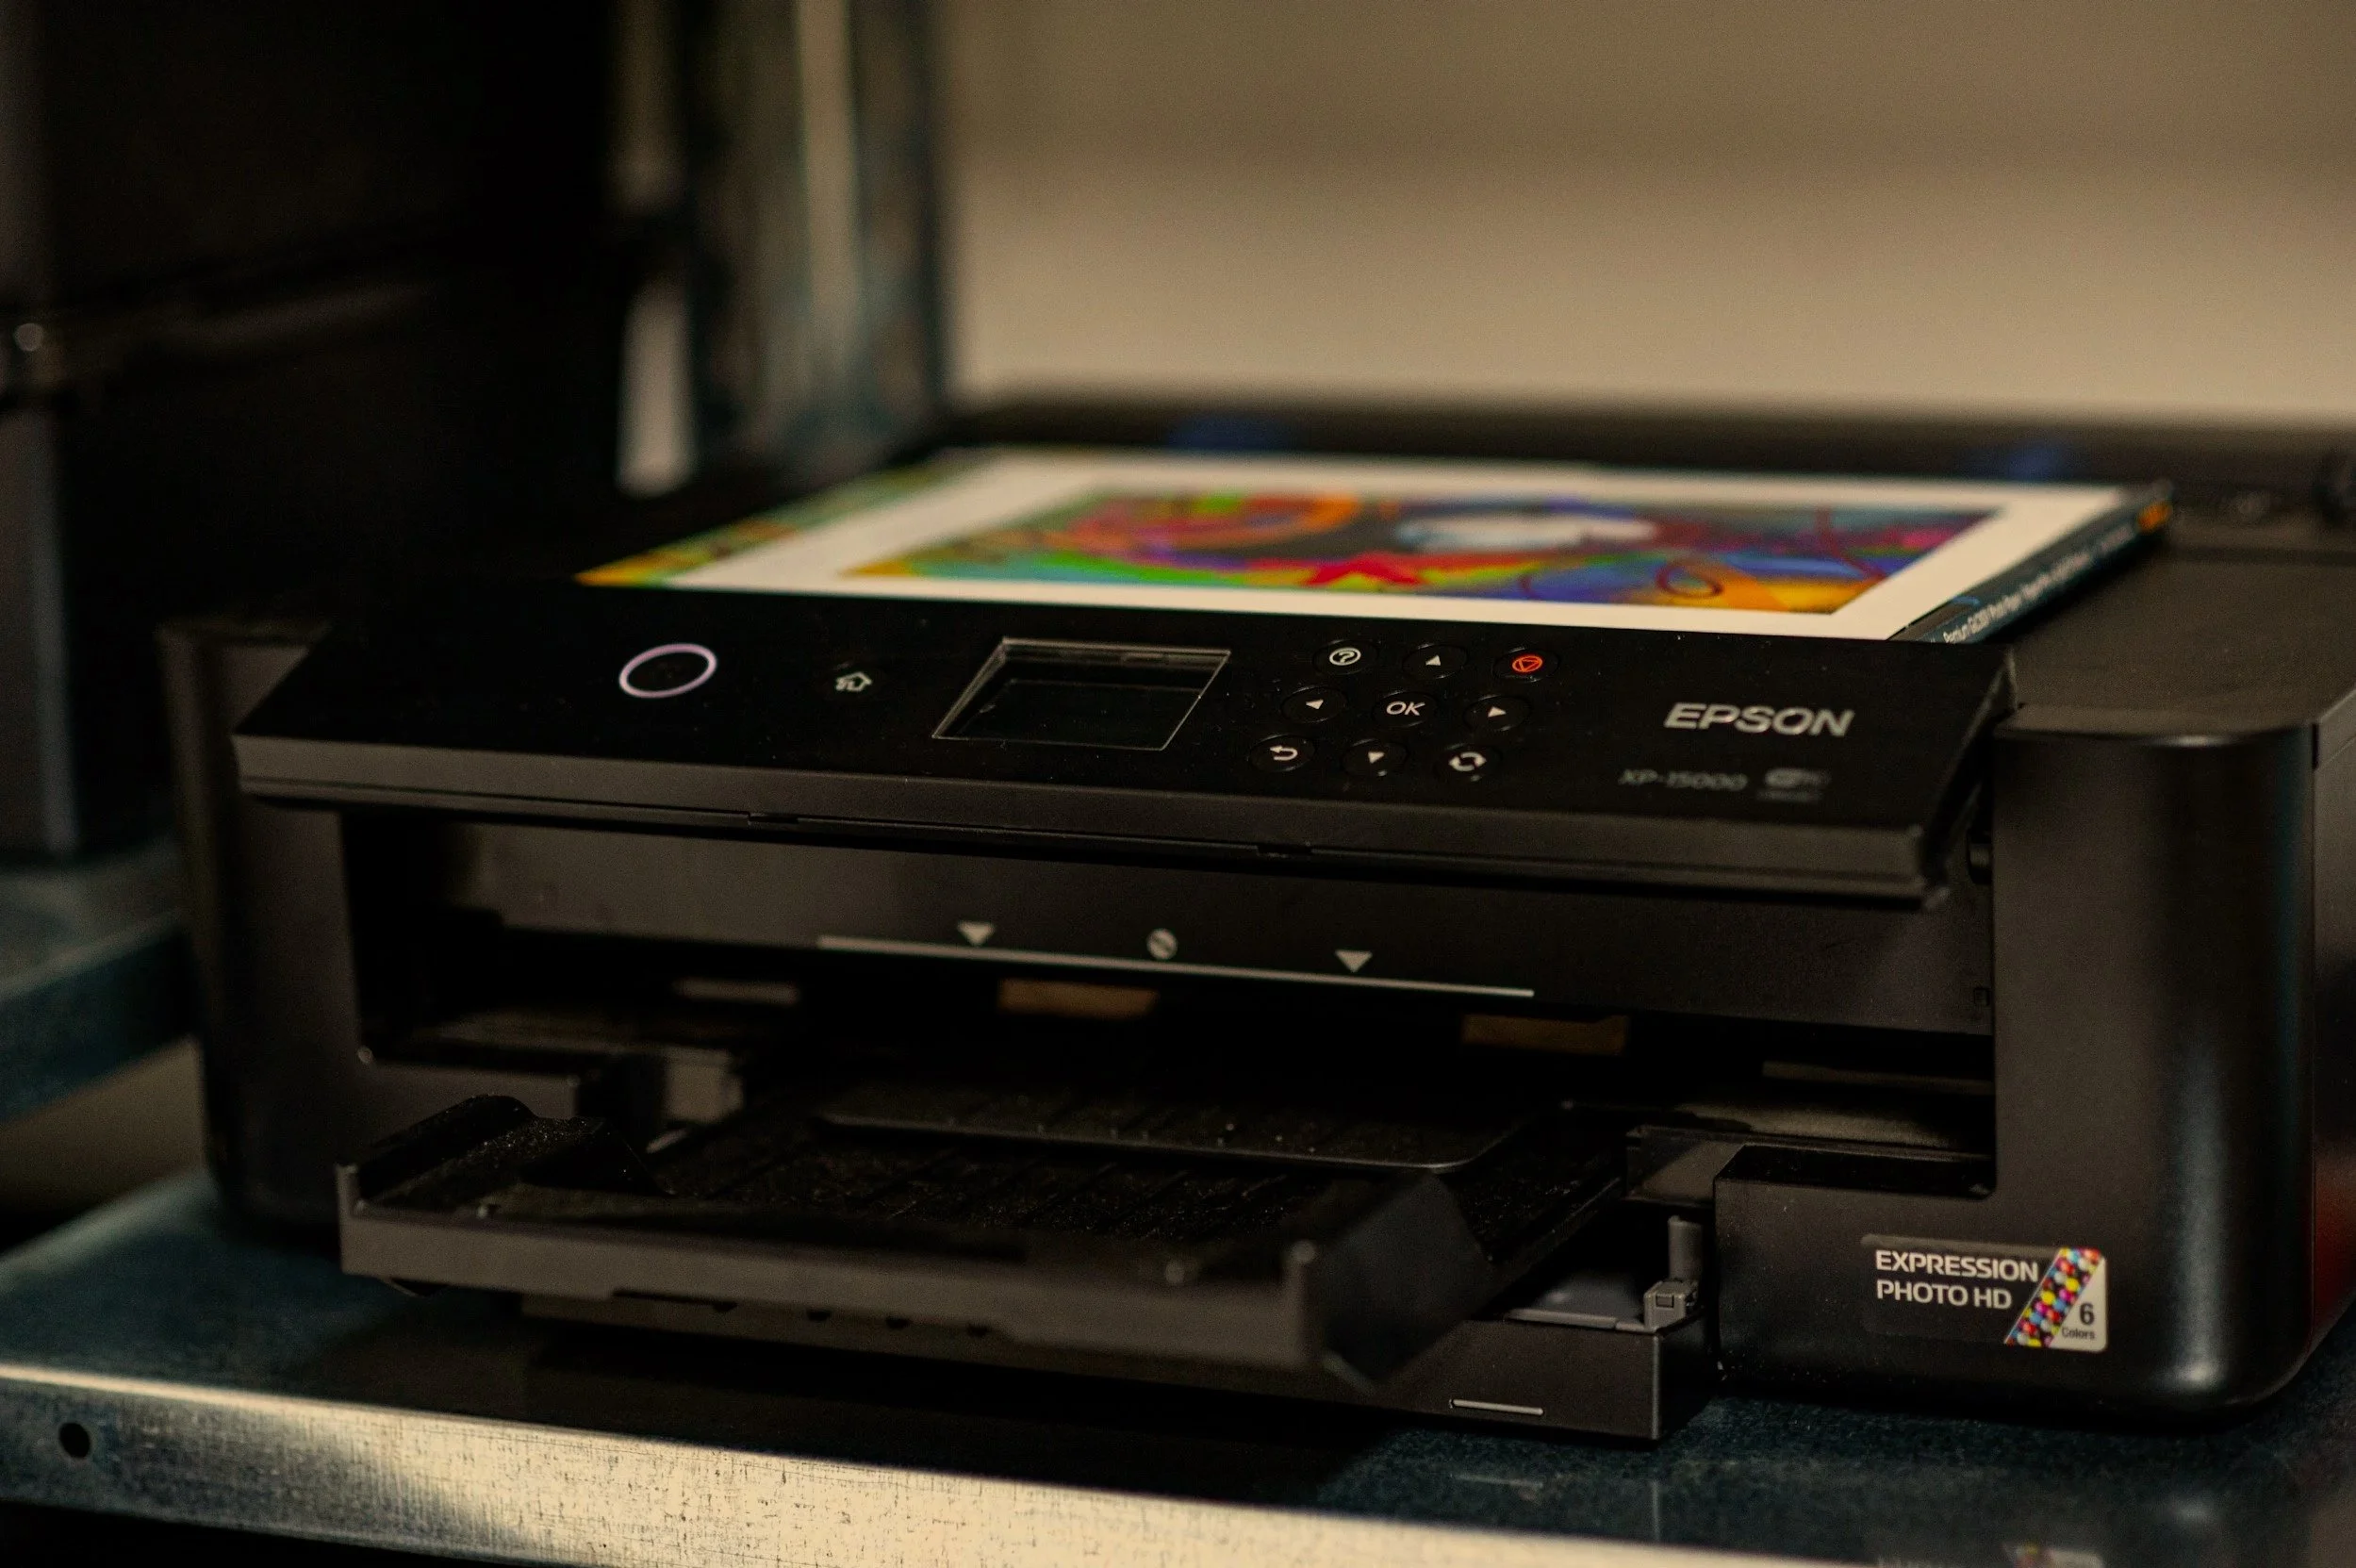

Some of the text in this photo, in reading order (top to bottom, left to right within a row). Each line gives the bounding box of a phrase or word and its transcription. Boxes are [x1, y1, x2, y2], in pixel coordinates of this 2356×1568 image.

[1386, 701, 1426, 717] OK
[1662, 701, 1855, 737] EPSON
[1875, 1249, 2039, 1283] EXPRESSION
[1876, 1279, 2013, 1311] PHOTO HD
[2080, 1302, 2095, 1326] 6
[2062, 1327, 2096, 1340] Colors
